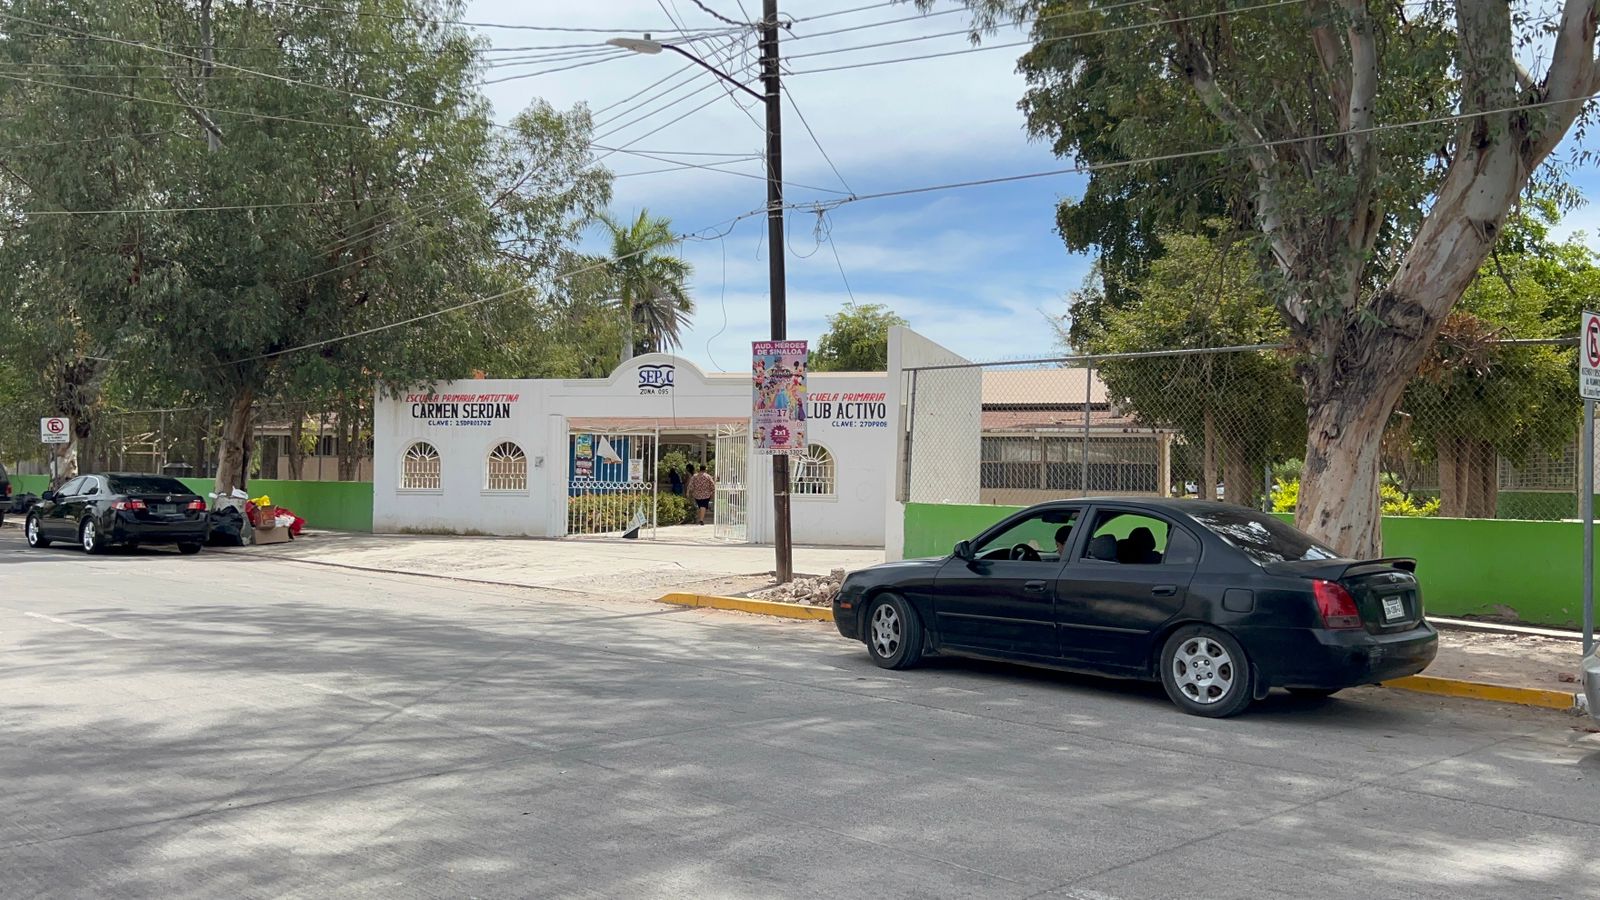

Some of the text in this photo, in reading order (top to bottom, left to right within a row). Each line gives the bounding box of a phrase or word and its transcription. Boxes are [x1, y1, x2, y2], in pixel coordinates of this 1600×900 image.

[441, 394, 475, 402] PRIMARIA
[475, 394, 519, 402] MATUTINA
[807, 393, 886, 401] CUELA PRIMARIA
[412, 403, 510, 418] CARMEN SERDAN
[777, 409, 787, 417] 17
[807, 403, 886, 419] LUB ACTIVO
